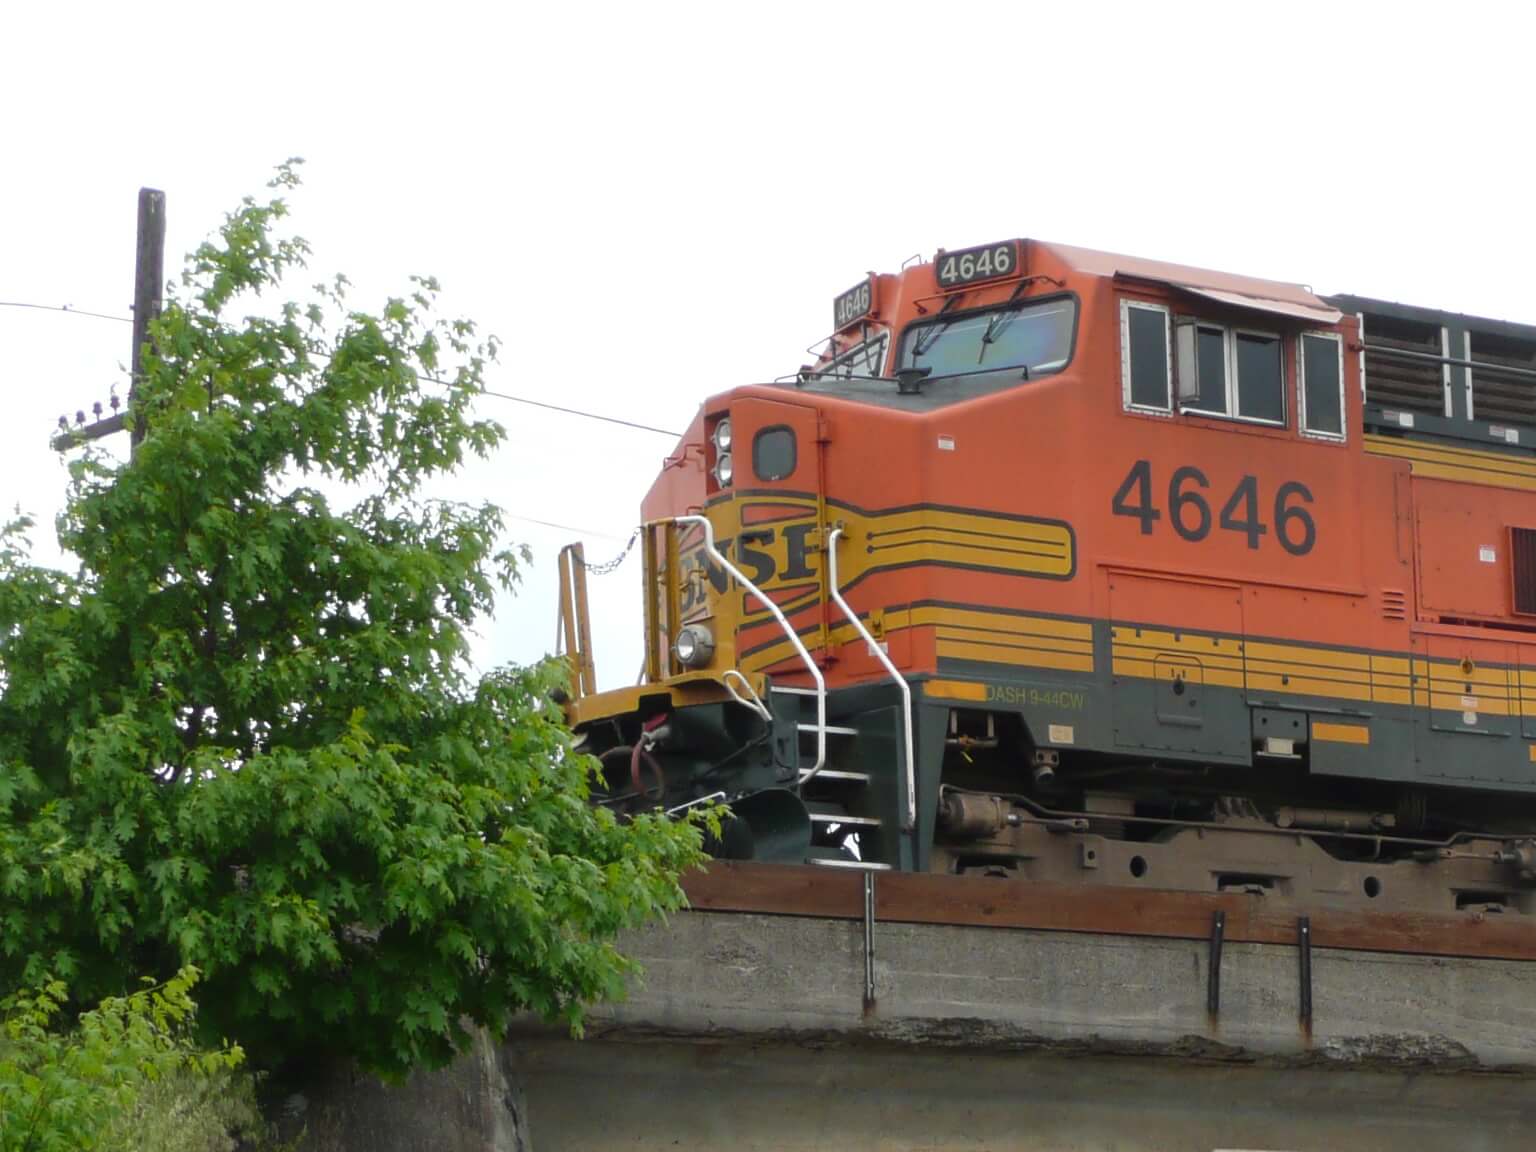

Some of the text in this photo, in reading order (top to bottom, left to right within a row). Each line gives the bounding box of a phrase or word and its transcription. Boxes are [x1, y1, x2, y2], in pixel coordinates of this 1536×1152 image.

[941, 246, 1010, 282] 4646
[837, 284, 870, 321] 4646
[1111, 459, 1317, 557] 4646
